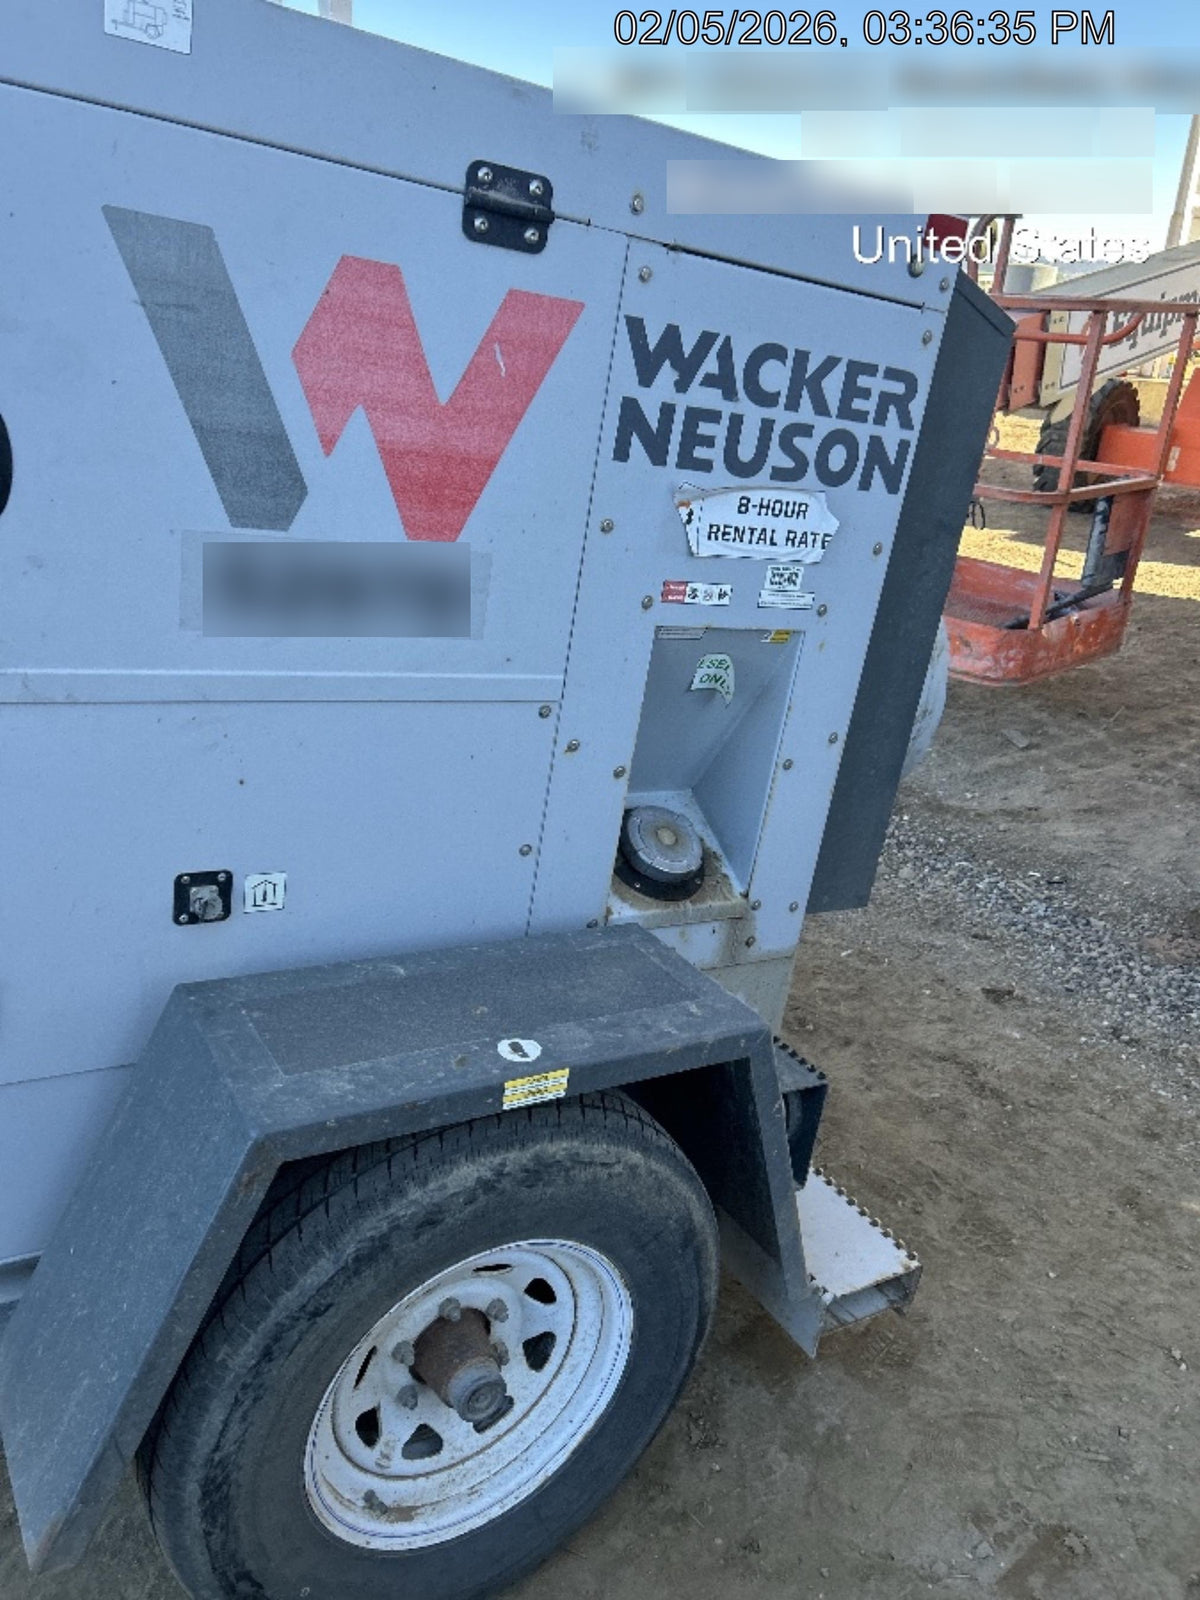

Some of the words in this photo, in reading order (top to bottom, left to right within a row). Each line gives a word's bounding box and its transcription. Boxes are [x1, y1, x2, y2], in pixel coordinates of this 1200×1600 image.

[624, 314, 918, 430] WACKER
[612, 396, 911, 495] NEUSON
[707, 524, 777, 546] RENTAL
[737, 496, 809, 520] 8-HOUR
